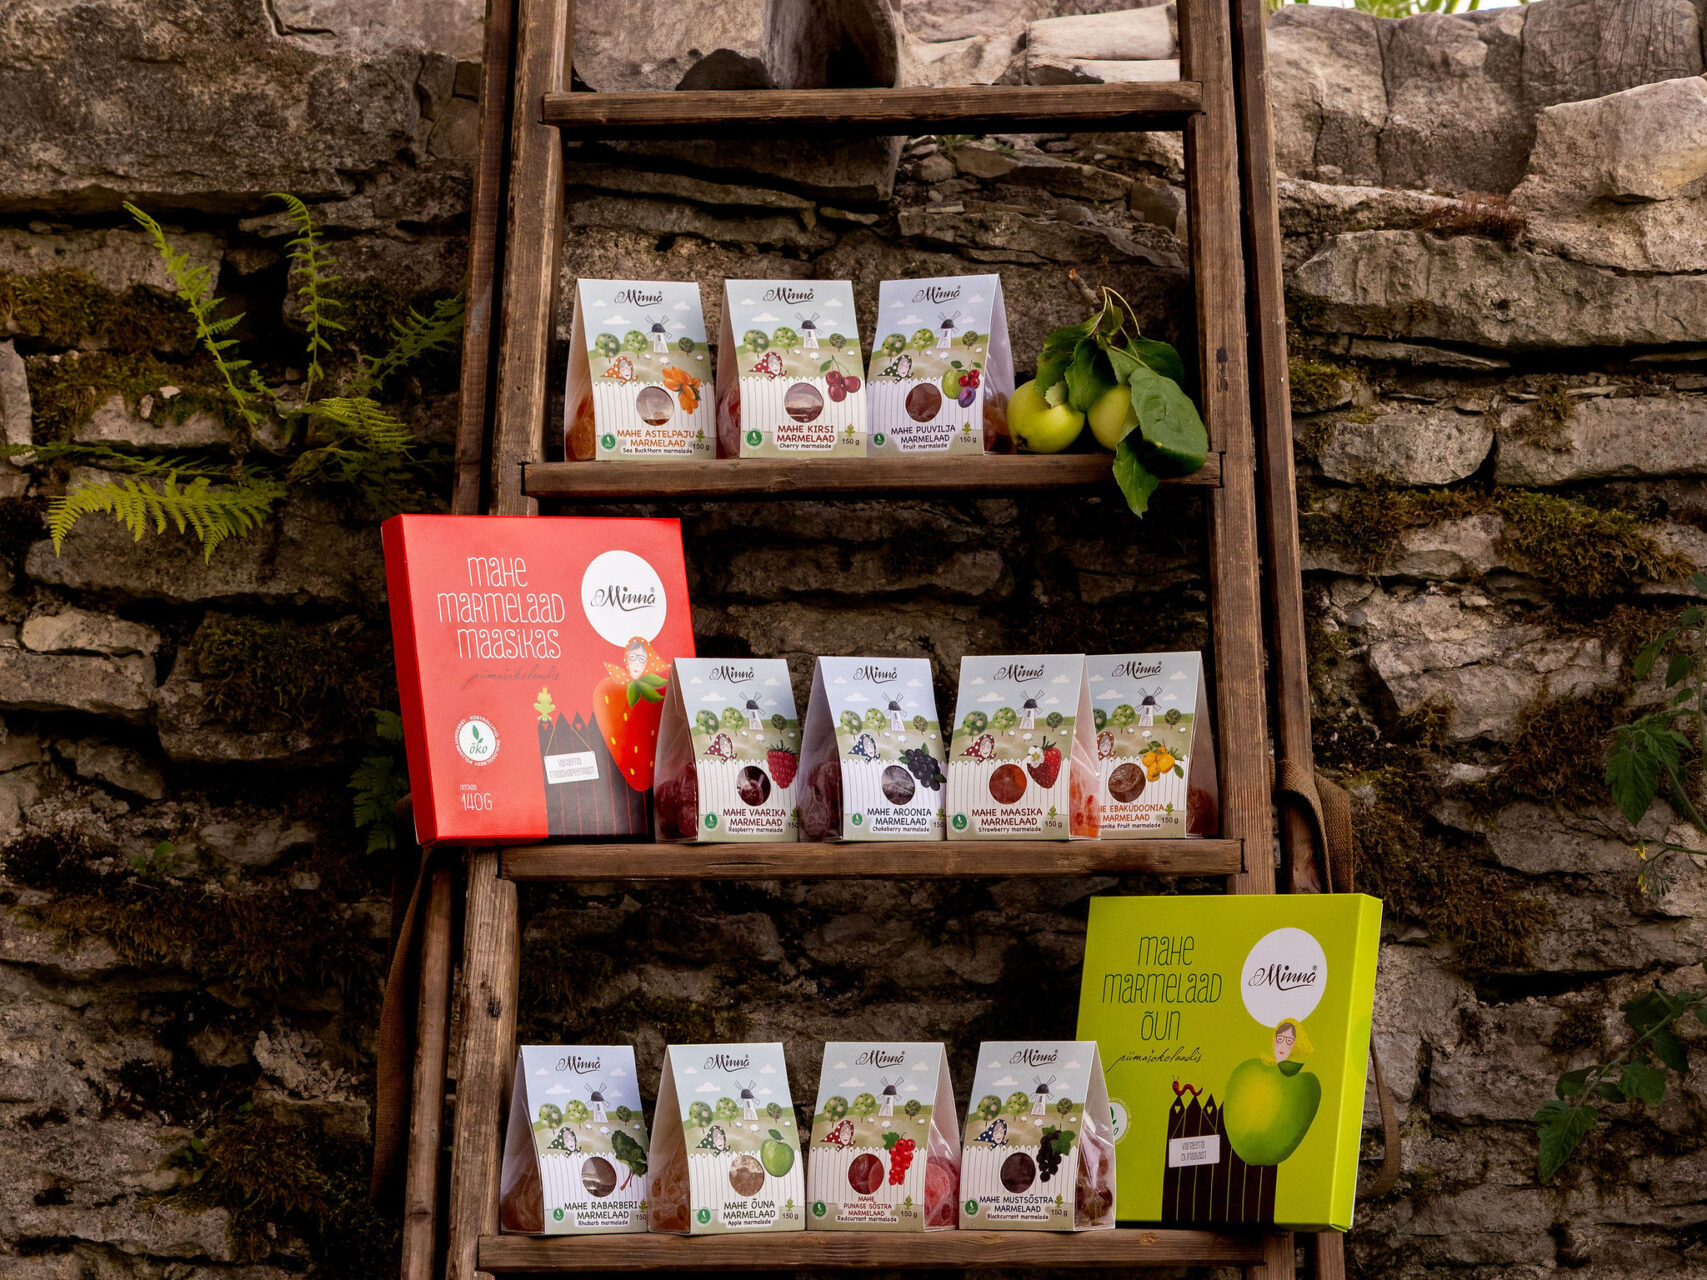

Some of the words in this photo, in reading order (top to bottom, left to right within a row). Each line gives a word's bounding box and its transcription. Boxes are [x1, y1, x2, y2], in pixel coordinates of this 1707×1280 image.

[778, 425, 804, 433] MAHE
[808, 425, 834, 433] KIRSI
[891, 427, 913, 435] MAHE
[916, 425, 956, 434] PUUVILJA
[617, 430, 641, 438] MAHE
[645, 430, 695, 438] ASTELPAJU
[777, 434, 835, 442] MARMELAAD
[630, 439, 686, 447] MARMELAAD
[900, 434, 950, 444] MARMELAAD
[590, 584, 656, 612] Minna
[749, 808, 786, 817] VAARIKA
[867, 808, 890, 816] MAHE
[893, 808, 932, 816] AROONIA
[971, 808, 997, 816] MAHE
[1000, 808, 1043, 817] MAASIKA
[1109, 803, 1165, 813] EBAKÜDOONIA
[729, 818, 783, 827] MARMELAAD
[875, 817, 927, 825] MARMELAAD
[981, 817, 1038, 826] MARMELAAD
[1102, 814, 1150, 822] MARMELAAD
[1248, 963, 1318, 991] Minna
[979, 1196, 1000, 1204] MAHE
[1002, 1194, 1053, 1204] MUSTSÕSTRA
[564, 1202, 588, 1211] MAHE
[591, 1201, 638, 1210] RABARBERI
[723, 1201, 747, 1210] MAHE
[751, 1198, 775, 1209] ÕUNA
[868, 1201, 892, 1210] SÕSTRA
[994, 1205, 1041, 1213] MARMELAAD
[576, 1211, 629, 1219] MARMELAAD
[723, 1210, 776, 1220] MARMELAAD
